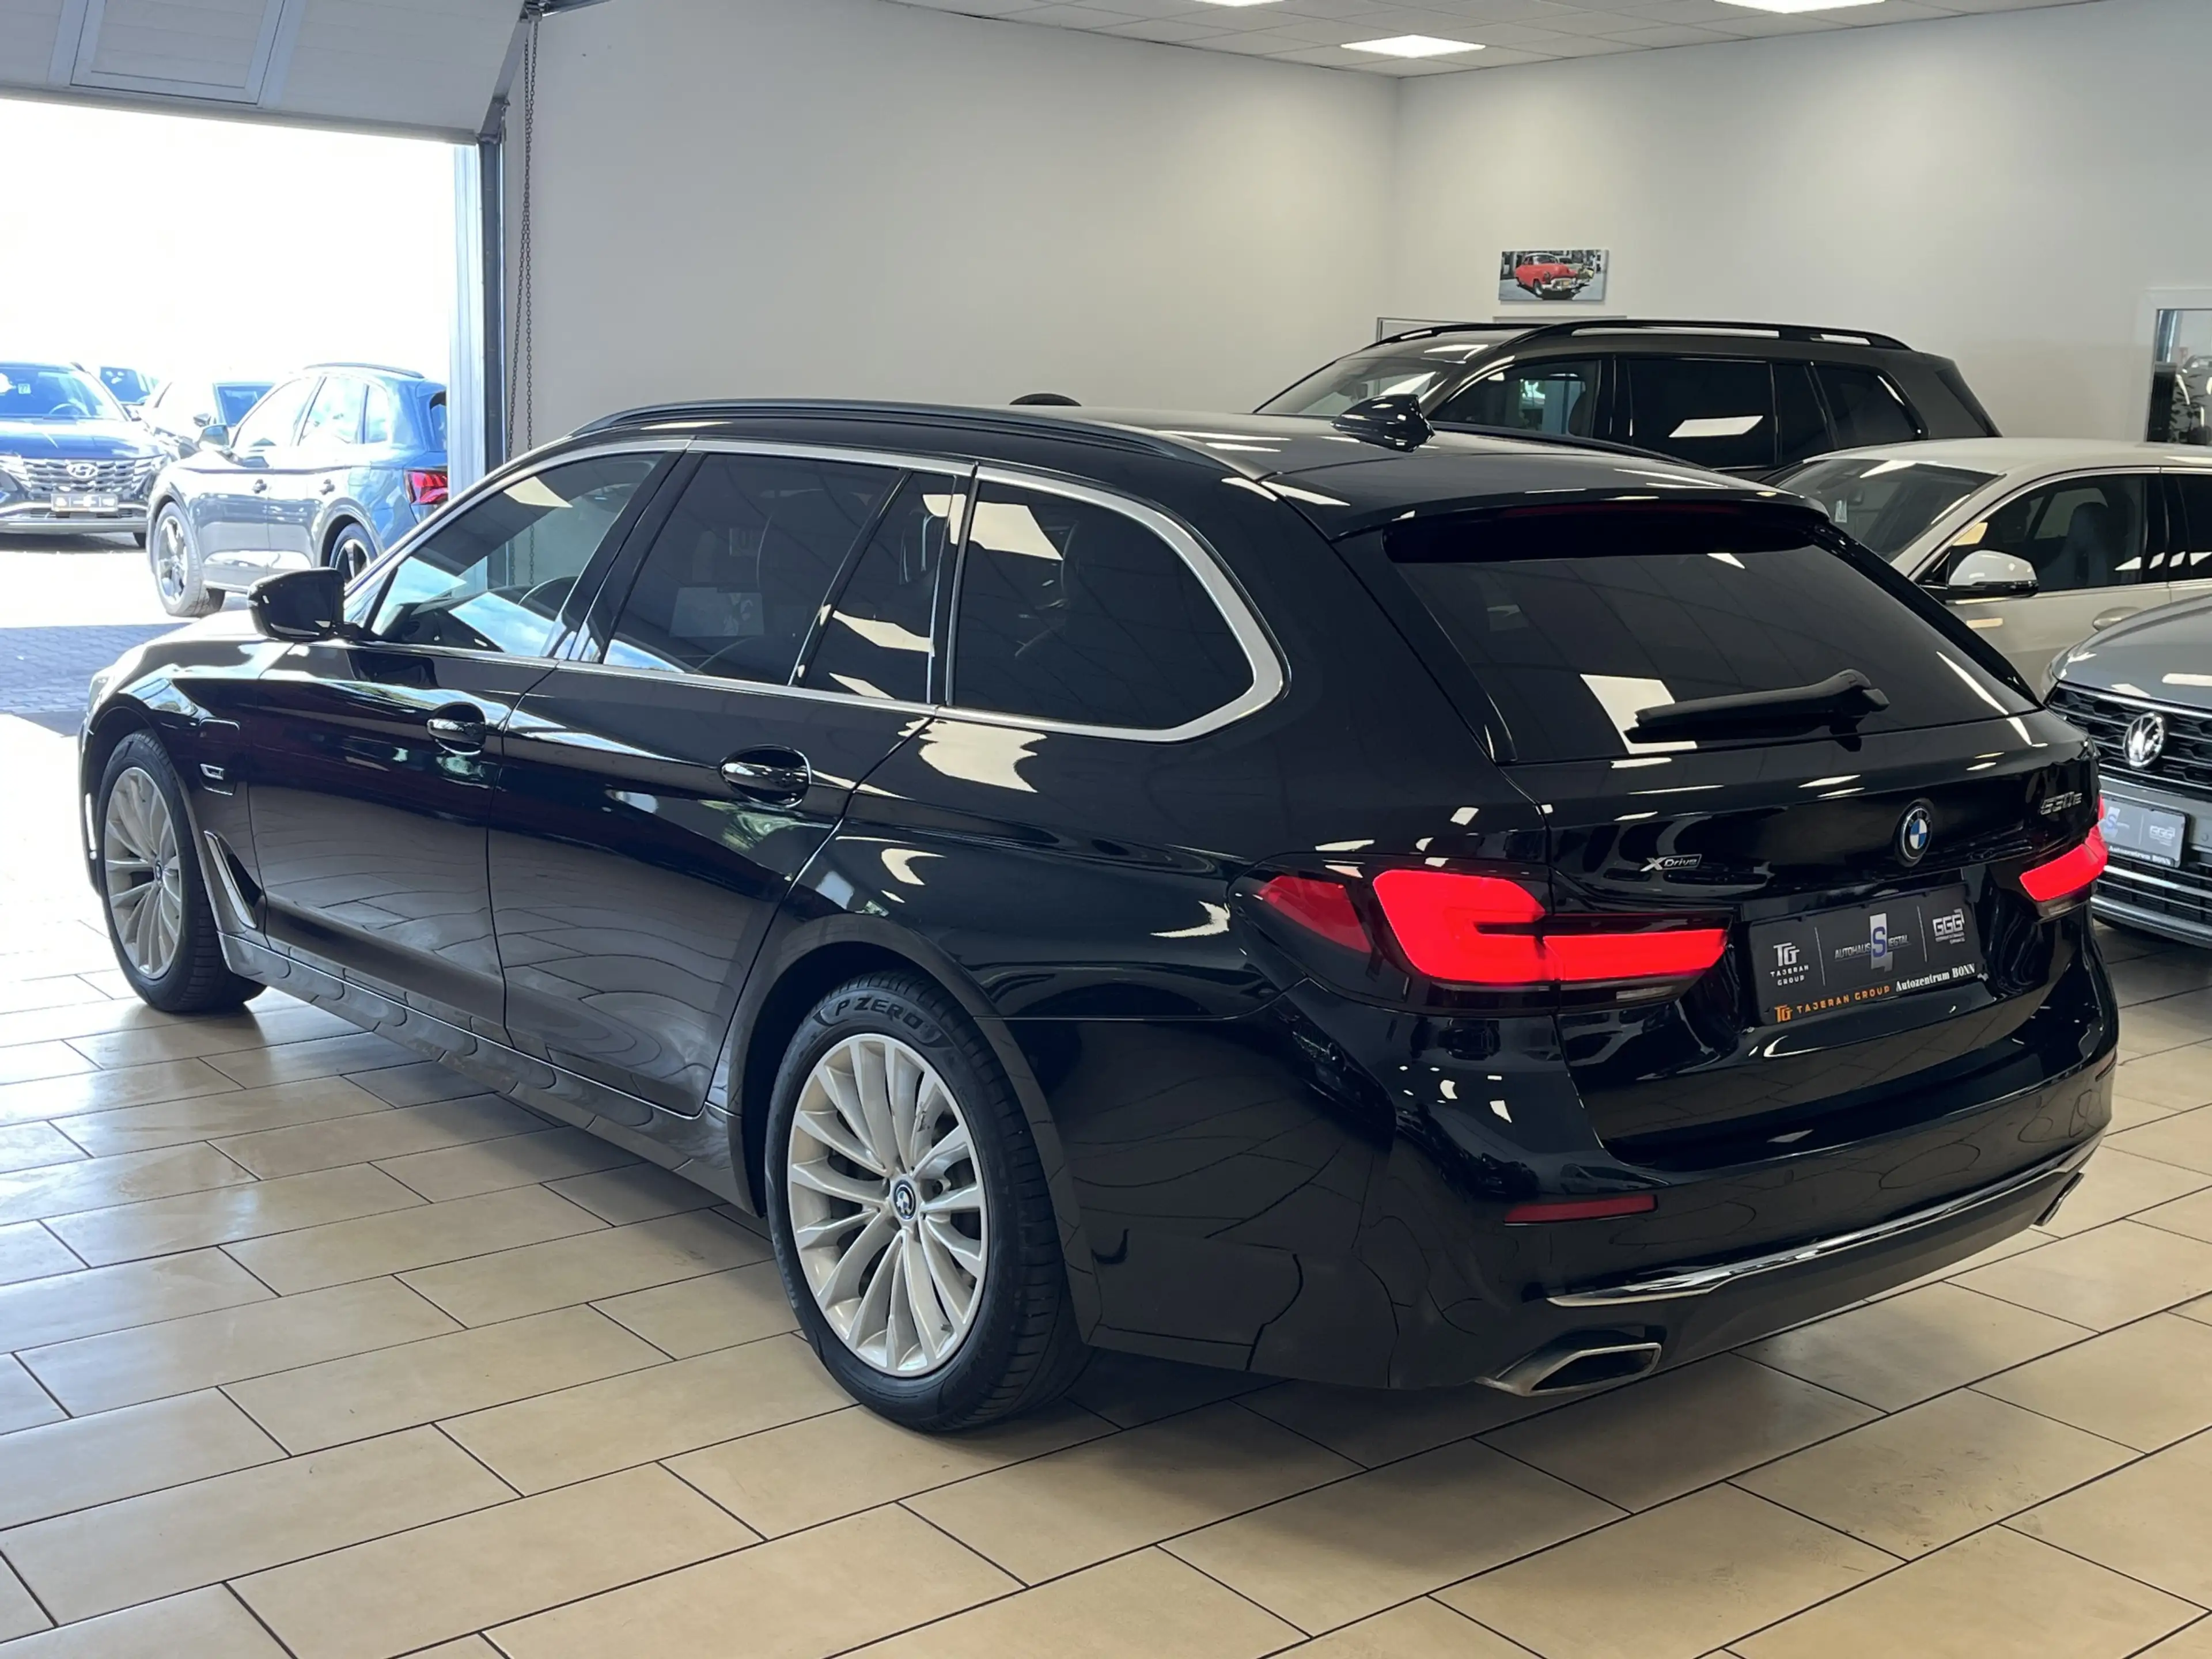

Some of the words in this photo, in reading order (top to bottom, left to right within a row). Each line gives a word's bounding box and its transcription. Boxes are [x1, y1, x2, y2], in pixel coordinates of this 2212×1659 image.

[1777, 975, 1805, 986] GROUP
[1896, 972, 1950, 992] Autozentrum
[1952, 963, 1975, 978] BONN
[835, 999, 851, 1016] P
[854, 997, 925, 1029] ZERO
[1797, 994, 1850, 1014] TAJERAN
[1854, 985, 1891, 1001] GROUP
